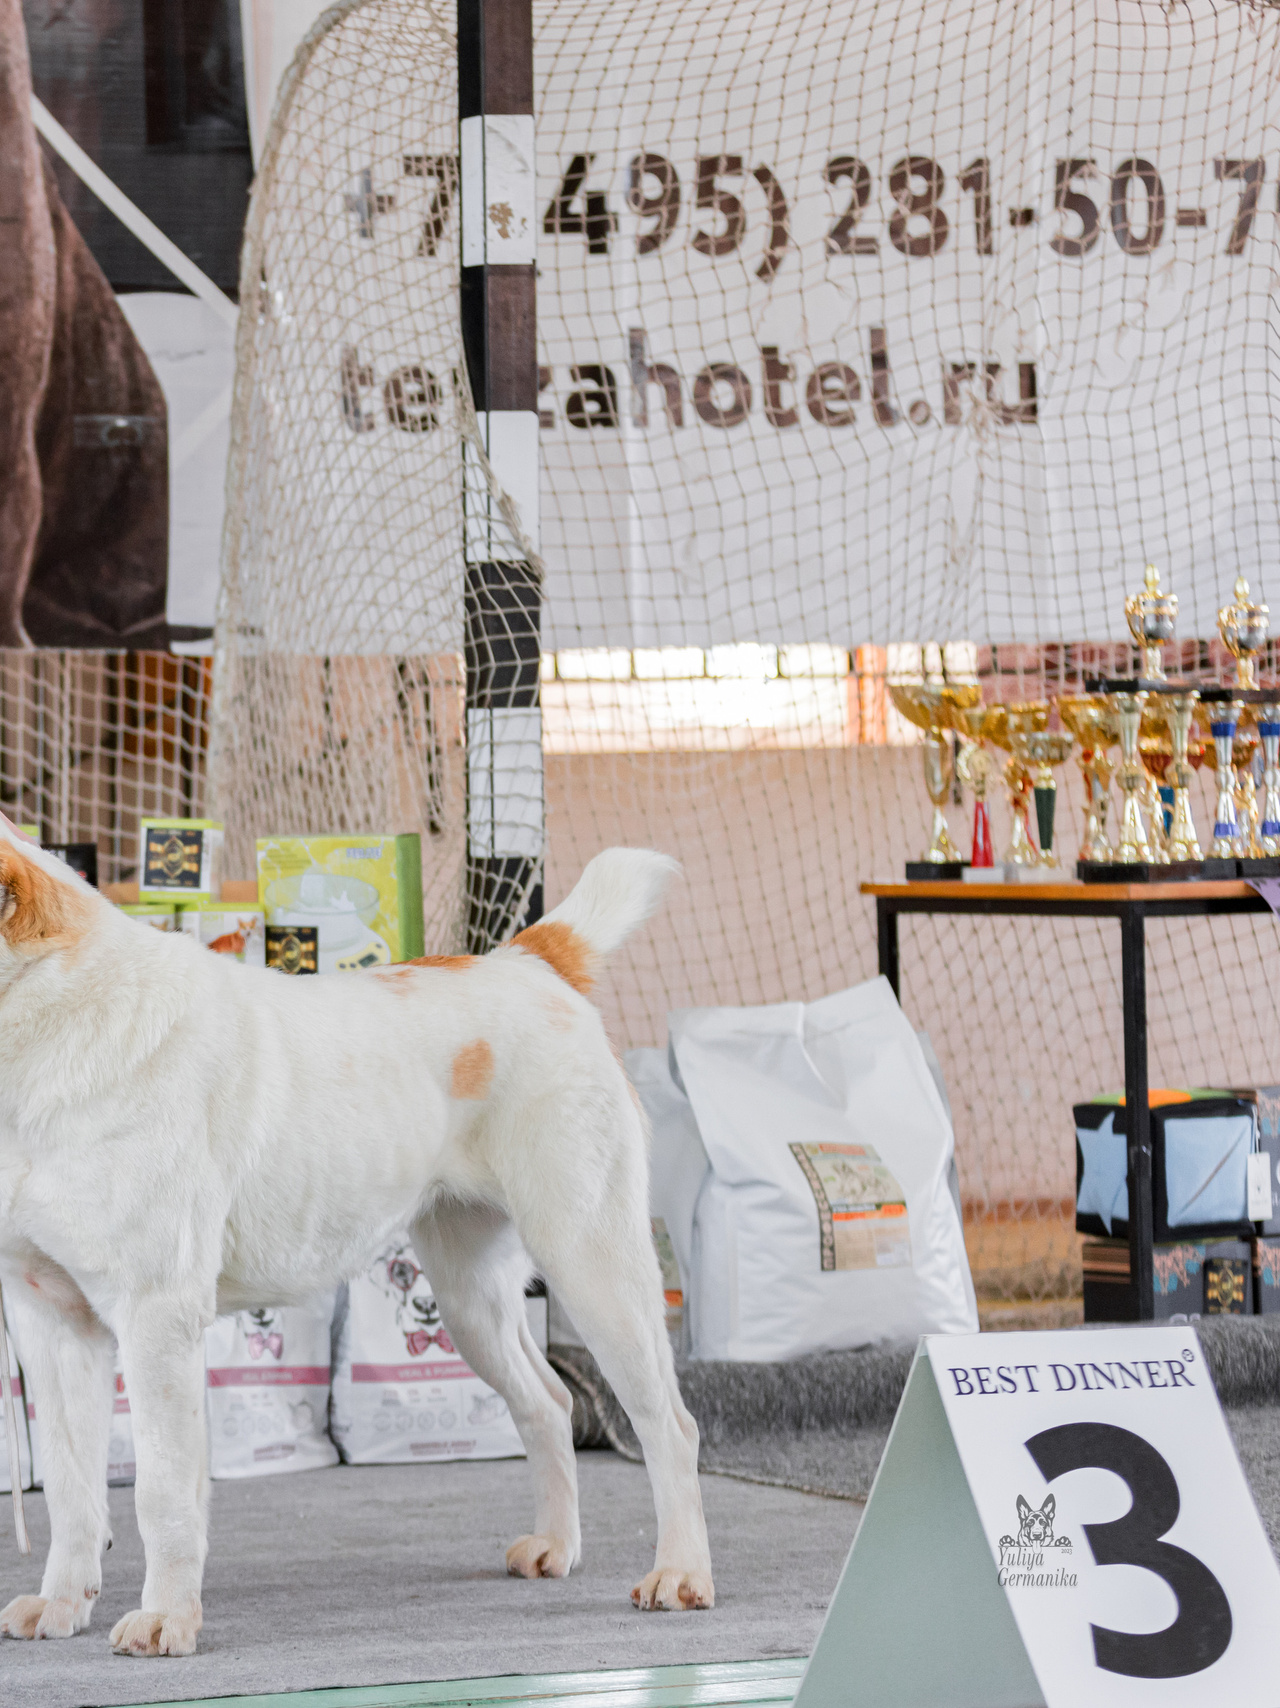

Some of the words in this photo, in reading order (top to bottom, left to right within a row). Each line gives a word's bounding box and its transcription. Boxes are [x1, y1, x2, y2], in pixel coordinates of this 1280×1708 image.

[542, 152, 790, 285] 495)
[822, 155, 1280, 257] 281-50-7
[948, 1365, 1040, 1396] BEST
[1049, 1359, 1196, 1392] DINNER
[1024, 1422, 1233, 1679] 3
